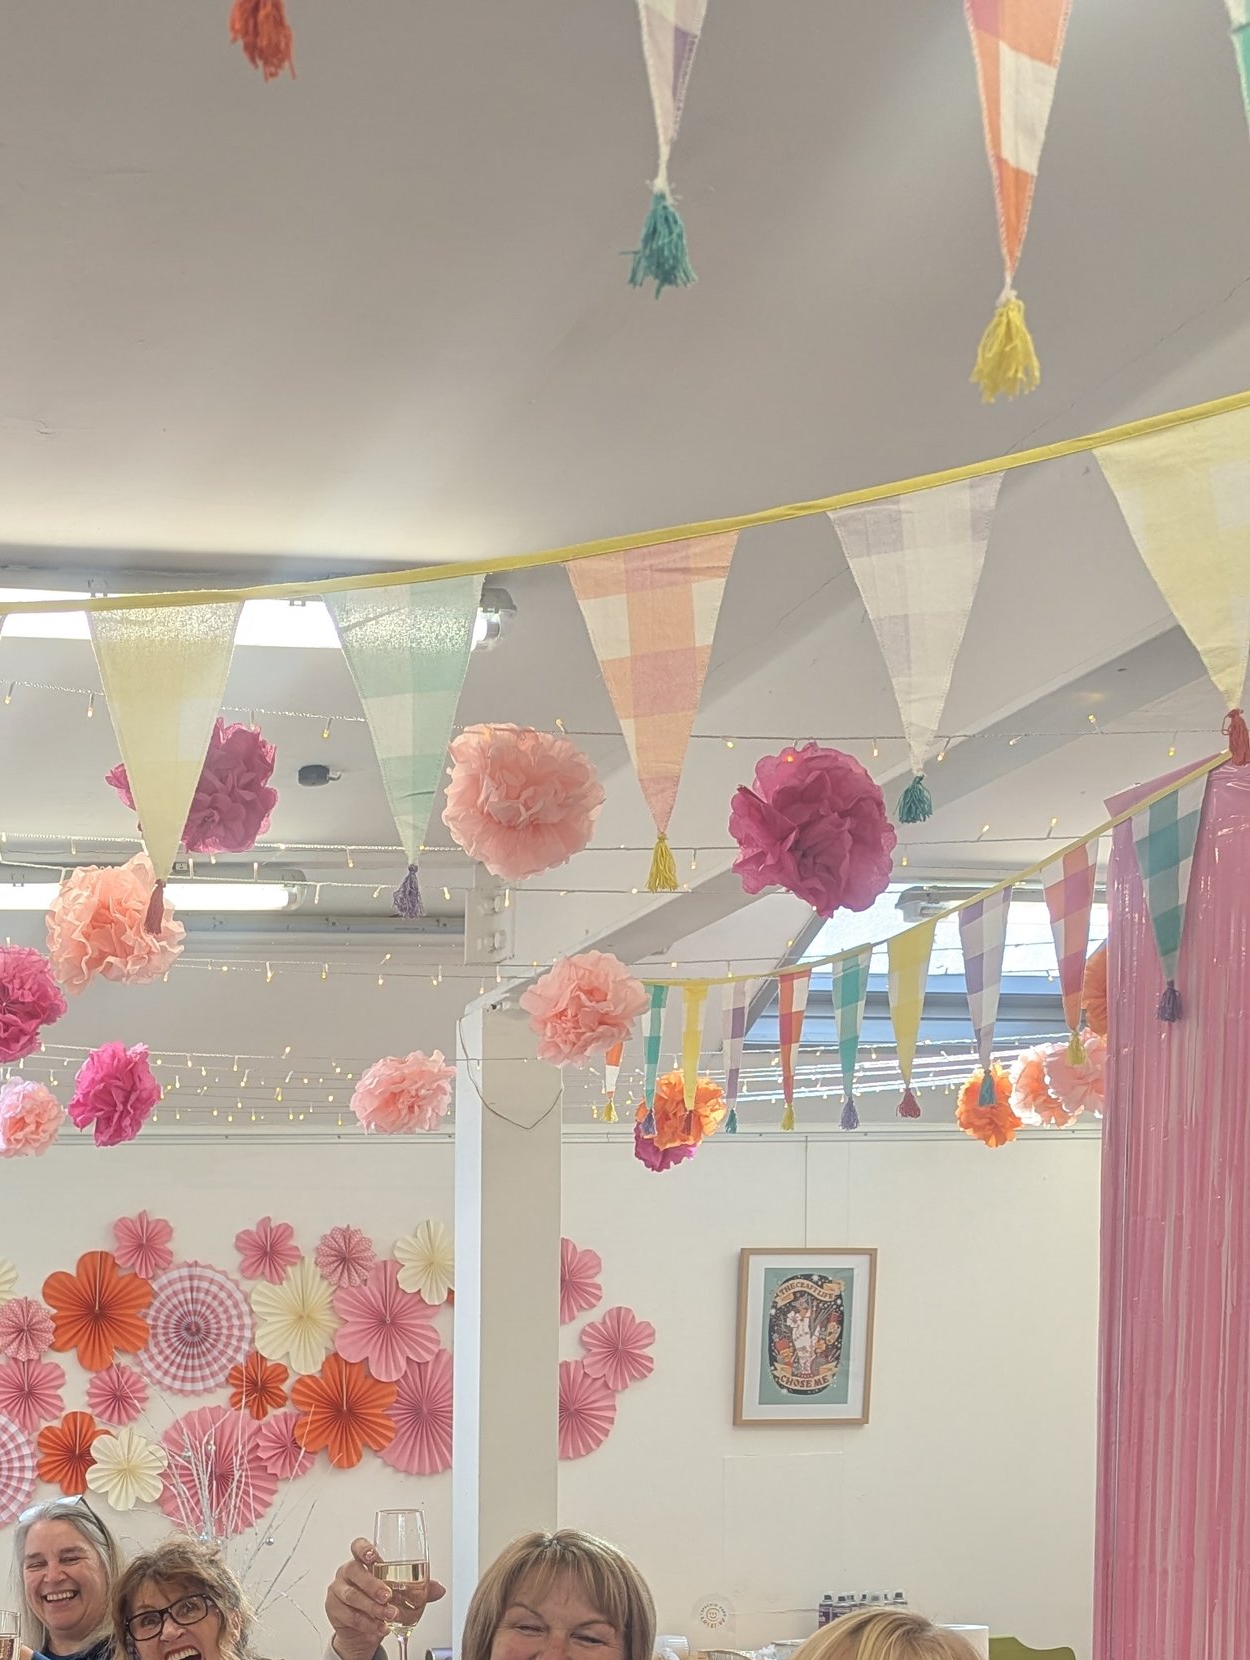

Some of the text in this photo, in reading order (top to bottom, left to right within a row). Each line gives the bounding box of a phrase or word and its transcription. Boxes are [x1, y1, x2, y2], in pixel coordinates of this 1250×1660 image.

[779, 1281, 834, 1299] THE CRAFT LIFE
[780, 1375, 830, 1388] CHOSE ME
